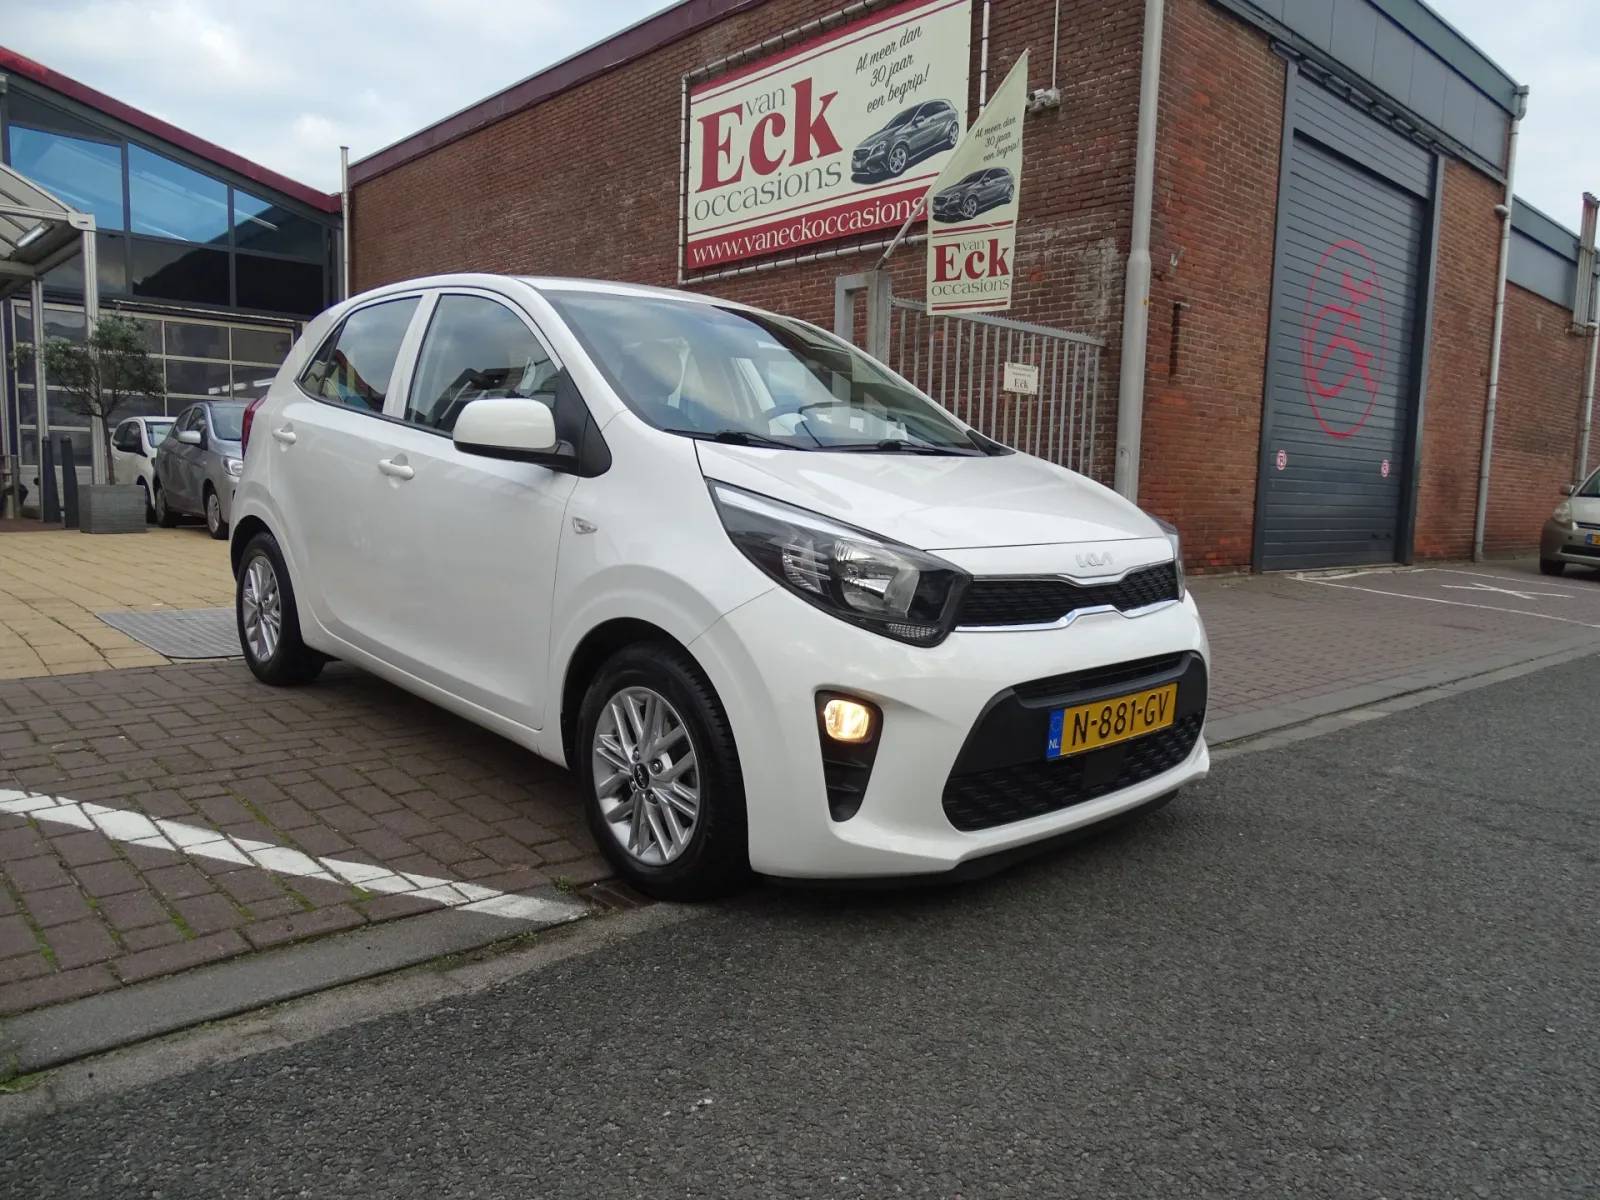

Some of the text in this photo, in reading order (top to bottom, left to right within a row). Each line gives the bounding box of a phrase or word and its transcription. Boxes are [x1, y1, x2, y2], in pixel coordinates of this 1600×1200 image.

[855, 26, 922, 75] Al meer dan
[870, 54, 914, 88] 30 jaar
[745, 88, 786, 116] van
[866, 63, 930, 113] een begrip!
[695, 77, 843, 193] Eck
[984, 135, 995, 148] 30
[694, 161, 842, 221] occasions
[693, 196, 927, 264] www.vaneckoccasions
[962, 240, 985, 251] van
[932, 238, 1010, 283] Eck
[931, 278, 1010, 297] occasions
[1071, 690, 1170, 747] N-881-GV
[1048, 738, 1059, 750] NL
